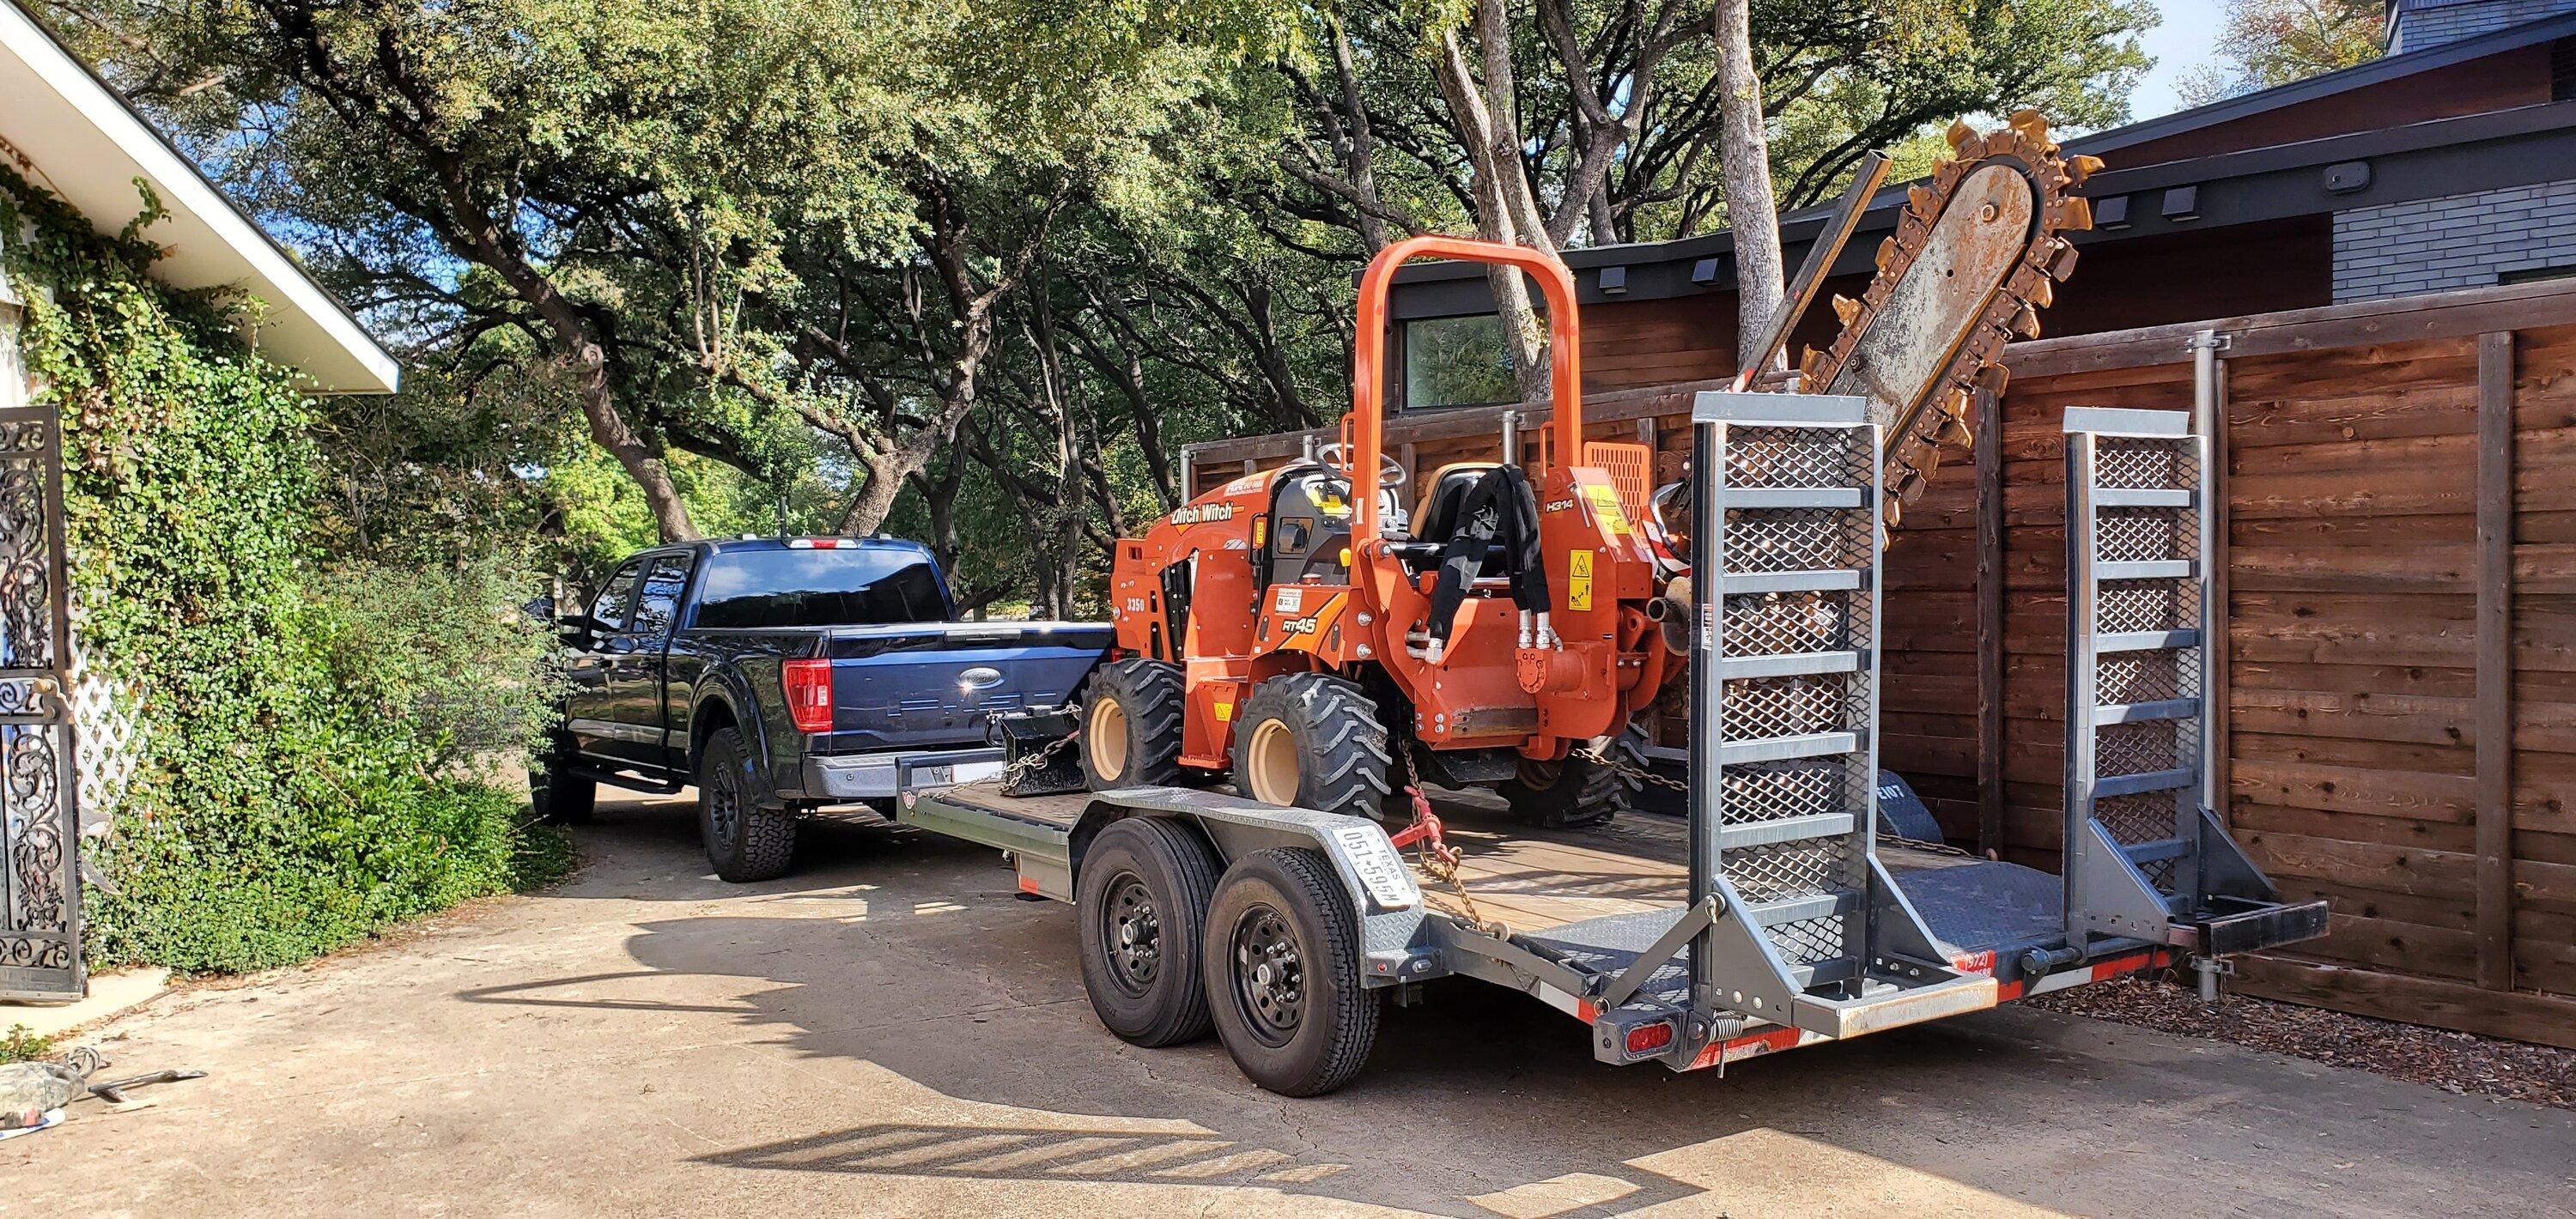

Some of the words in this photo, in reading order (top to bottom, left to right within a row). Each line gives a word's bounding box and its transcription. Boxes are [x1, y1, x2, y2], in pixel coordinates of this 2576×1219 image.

[1170, 505, 1200, 525] Ditch
[1202, 501, 1234, 522] Witch
[1546, 498, 1573, 512] H314
[1127, 597, 1145, 612] 3350
[1282, 617, 1317, 634] RT45
[1379, 849, 1400, 880] TEXAS
